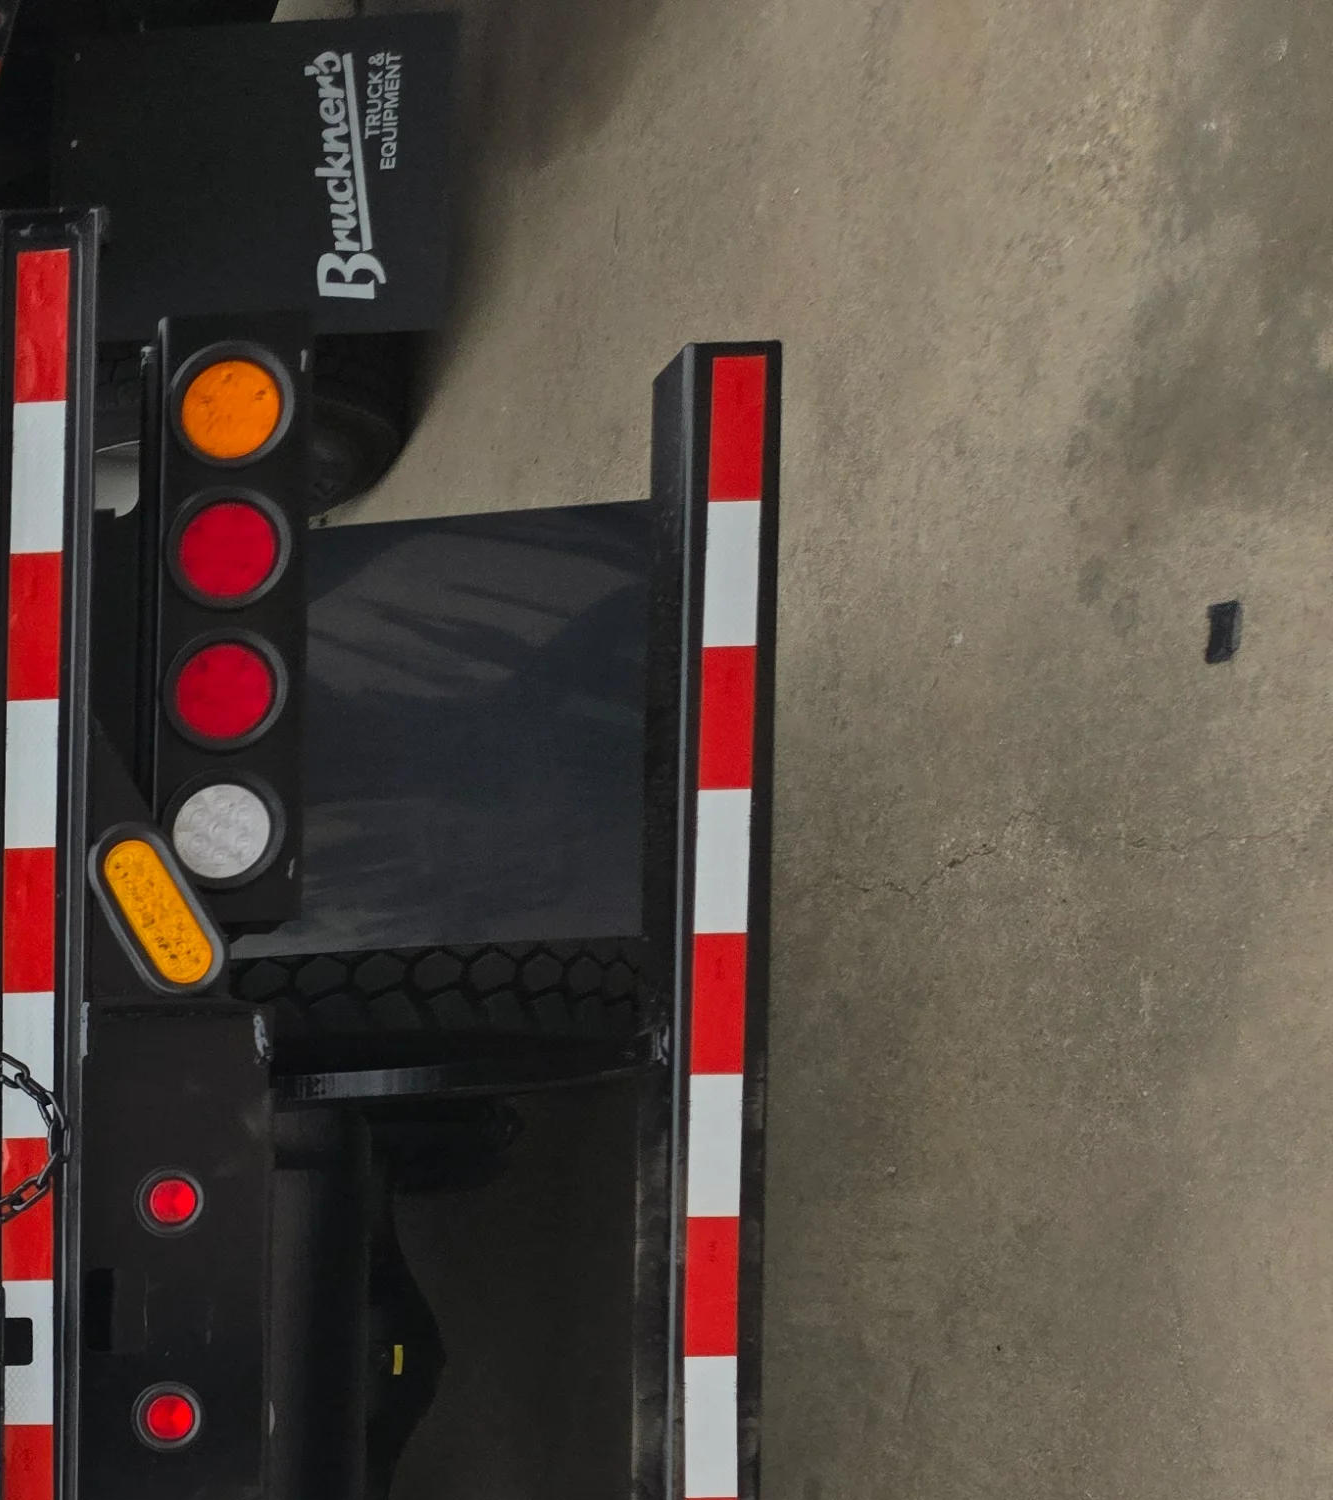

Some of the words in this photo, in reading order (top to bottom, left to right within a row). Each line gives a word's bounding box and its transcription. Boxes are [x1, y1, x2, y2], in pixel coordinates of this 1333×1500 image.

[364, 71, 383, 139] TRUCK
[370, 53, 386, 67] &
[380, 51, 402, 170] EQUIPMENT
[304, 51, 387, 299] Bruckner's
